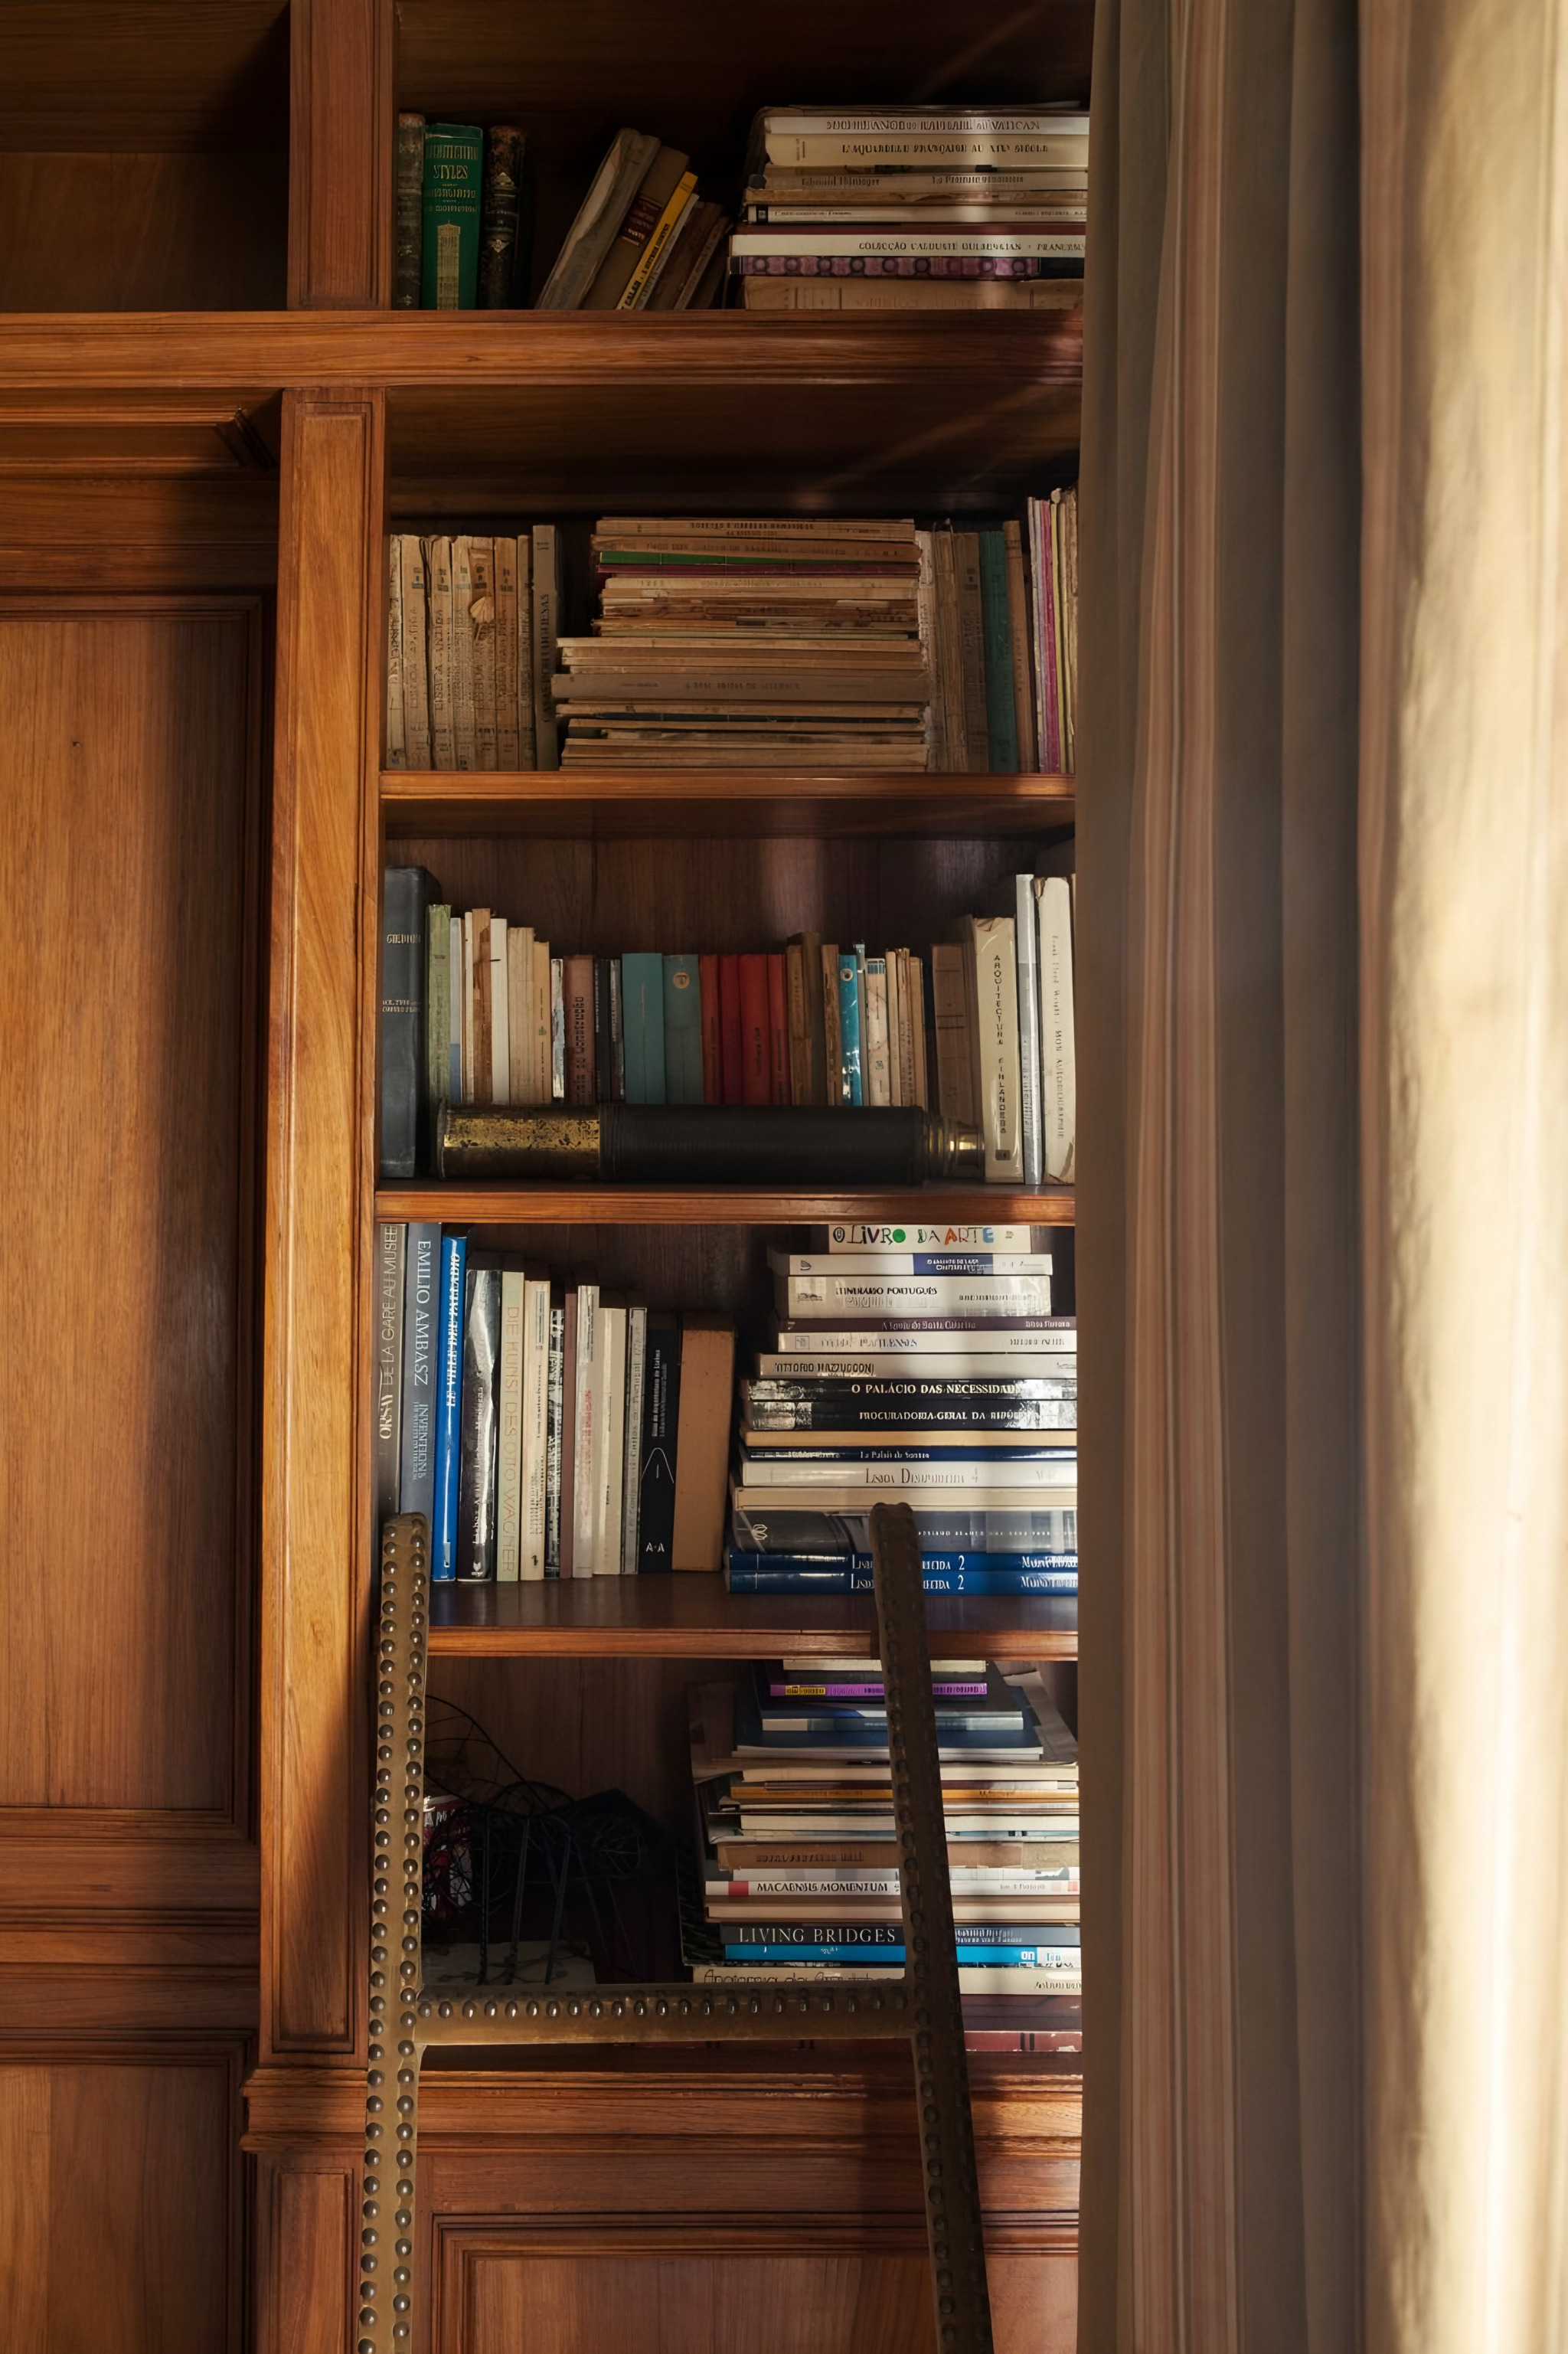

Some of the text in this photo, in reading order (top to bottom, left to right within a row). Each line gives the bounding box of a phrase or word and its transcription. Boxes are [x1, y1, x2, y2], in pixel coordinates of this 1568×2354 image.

[832, 1225, 995, 1245] O LIVRO DA ARTE
[416, 1241, 431, 1303] EMILIO
[383, 1279, 396, 1298] AU
[382, 1302, 395, 1340] GARE
[381, 1345, 394, 1362] LA
[414, 1309, 430, 1387] AMBASZ
[851, 1385, 861, 1394] O
[866, 1382, 916, 1394] PALÁCIO
[921, 1385, 942, 1394] DAS
[504, 1402, 517, 1436] DES
[958, 1555, 965, 1570] 2
[957, 1574, 965, 1590] 2
[740, 1927, 895, 1943] LIVING BRIDGES
